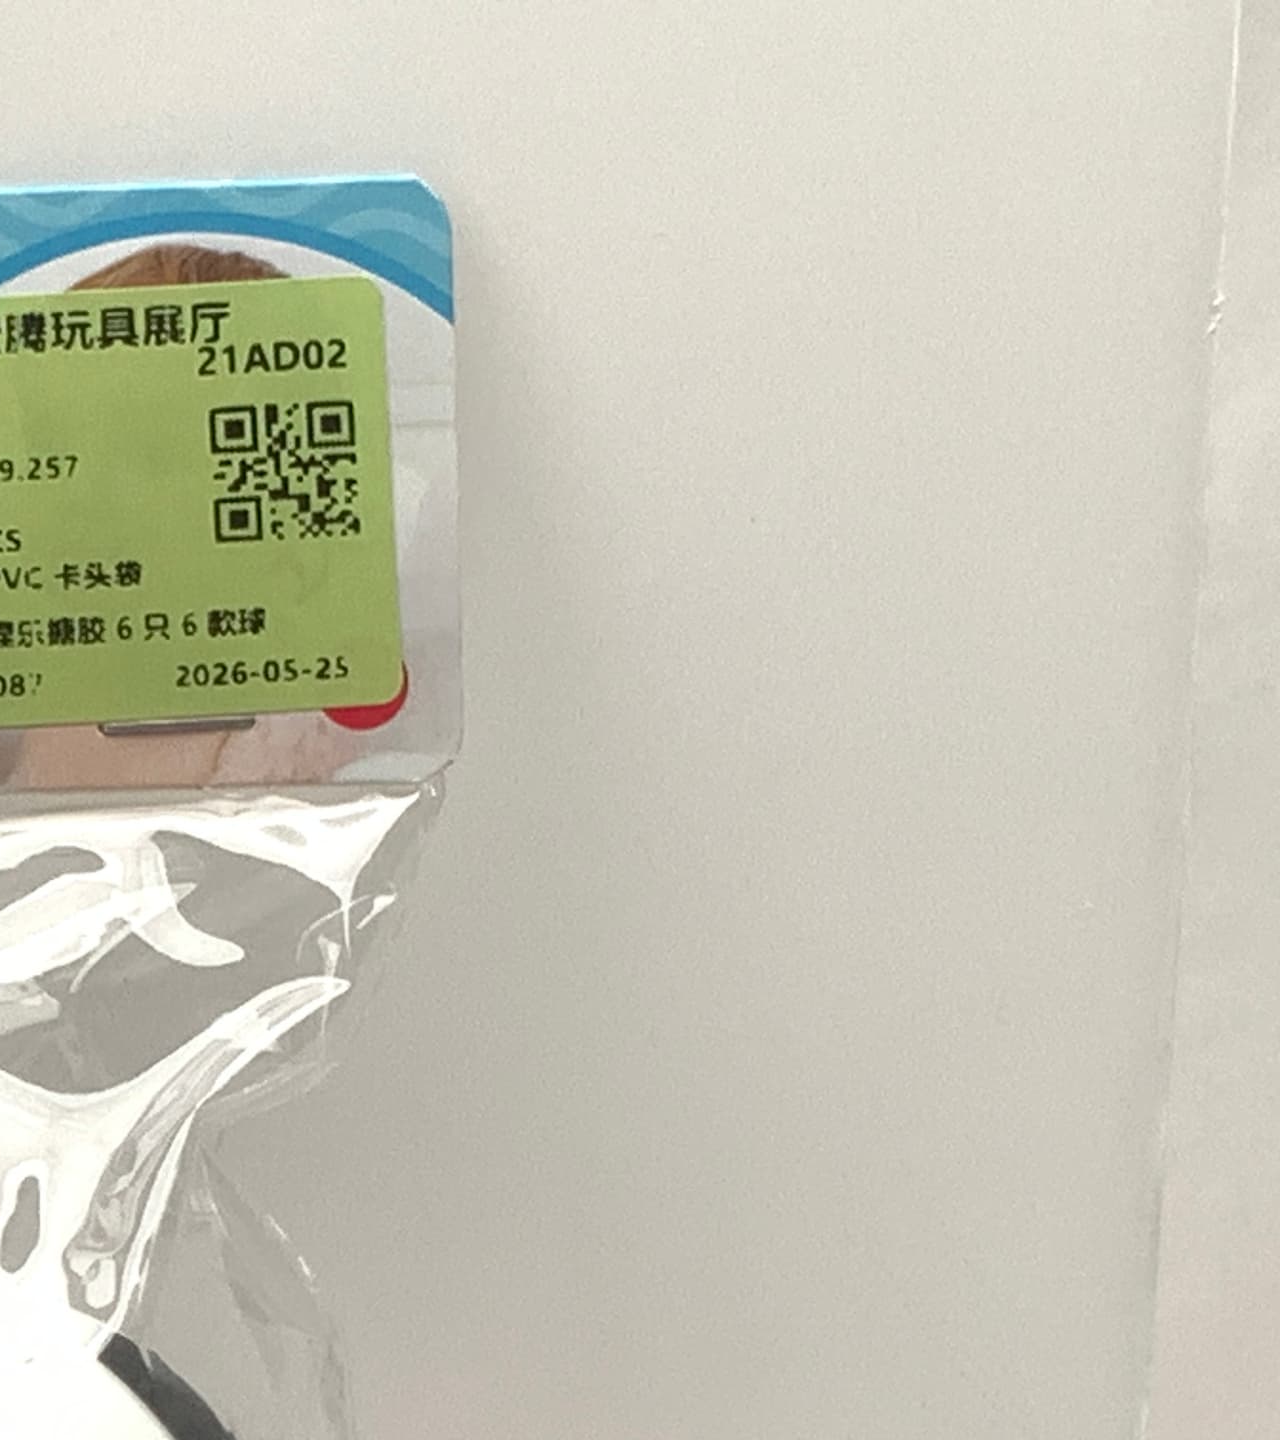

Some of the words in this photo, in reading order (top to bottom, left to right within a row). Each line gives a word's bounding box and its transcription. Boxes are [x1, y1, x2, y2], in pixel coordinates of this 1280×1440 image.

[198, 338, 346, 376] 21AD02
[0, 456, 78, 481] 9.257
[54, 560, 142, 590] 卡头袋
[117, 616, 132, 640] 6
[144, 613, 170, 640] 只
[182, 612, 197, 636] 6
[208, 607, 265, 638] 款球
[176, 656, 348, 687] 2026-05-25
